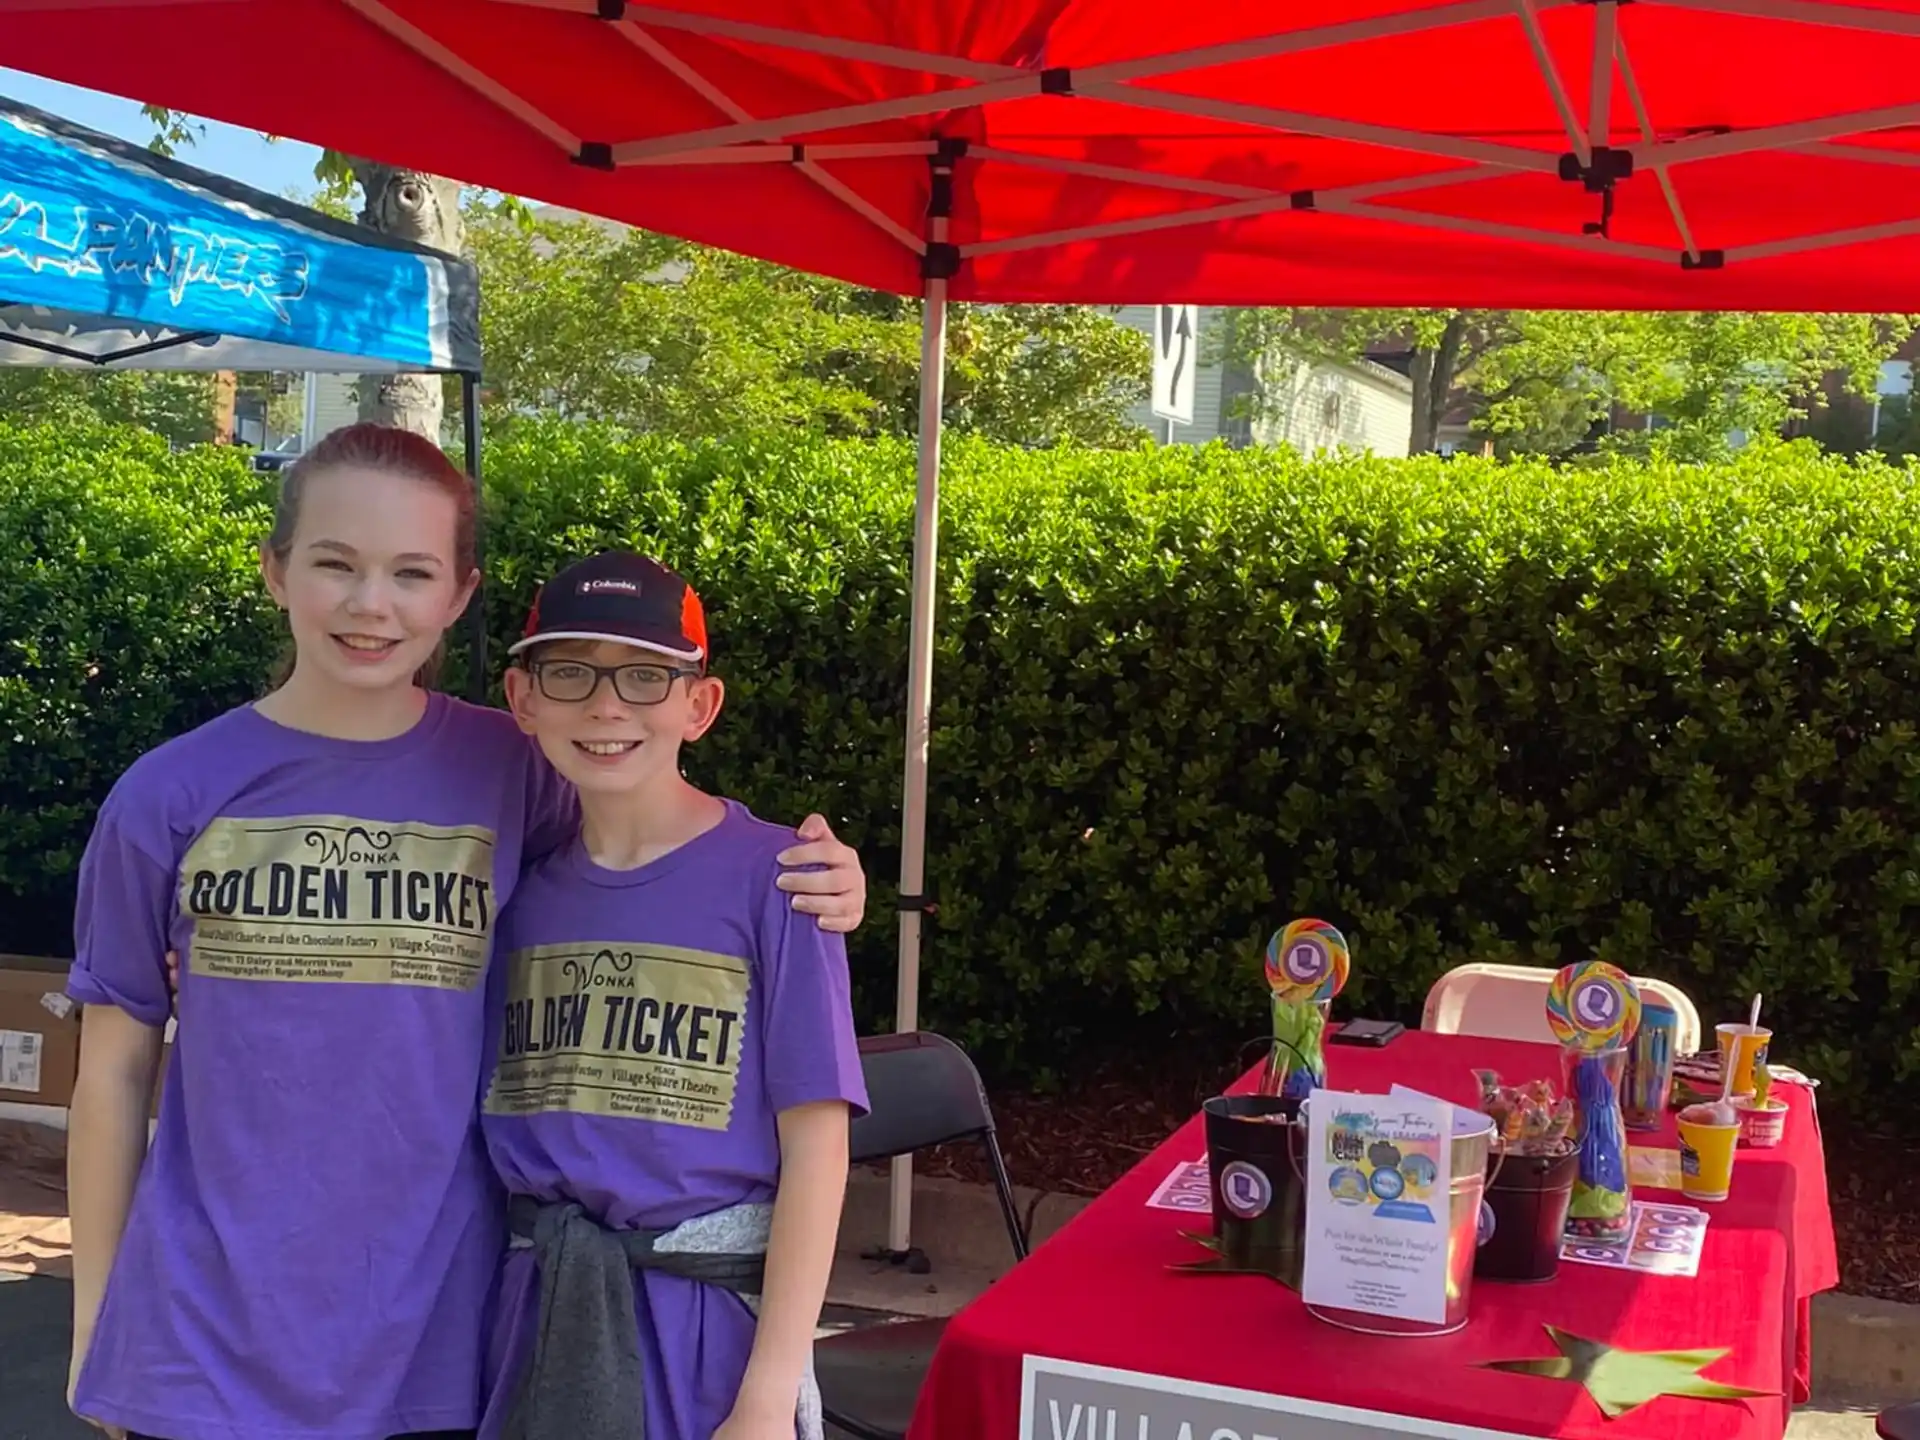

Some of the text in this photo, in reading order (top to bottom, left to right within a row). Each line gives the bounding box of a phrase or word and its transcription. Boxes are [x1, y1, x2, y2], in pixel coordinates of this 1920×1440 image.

[592, 579, 637, 591] Columbia
[304, 826, 400, 866] WONKA
[190, 862, 489, 932] GOLDEN TICKET
[268, 933, 284, 944] and
[286, 933, 300, 944] the
[346, 936, 378, 949] Factory
[390, 937, 423, 954] Village
[424, 940, 455, 957] Square
[275, 957, 292, 966] and
[563, 949, 635, 991] WONKA
[602, 996, 738, 1067] TICKET
[612, 1068, 720, 1096] Village Square Theatre
[661, 1107, 678, 1120] May
